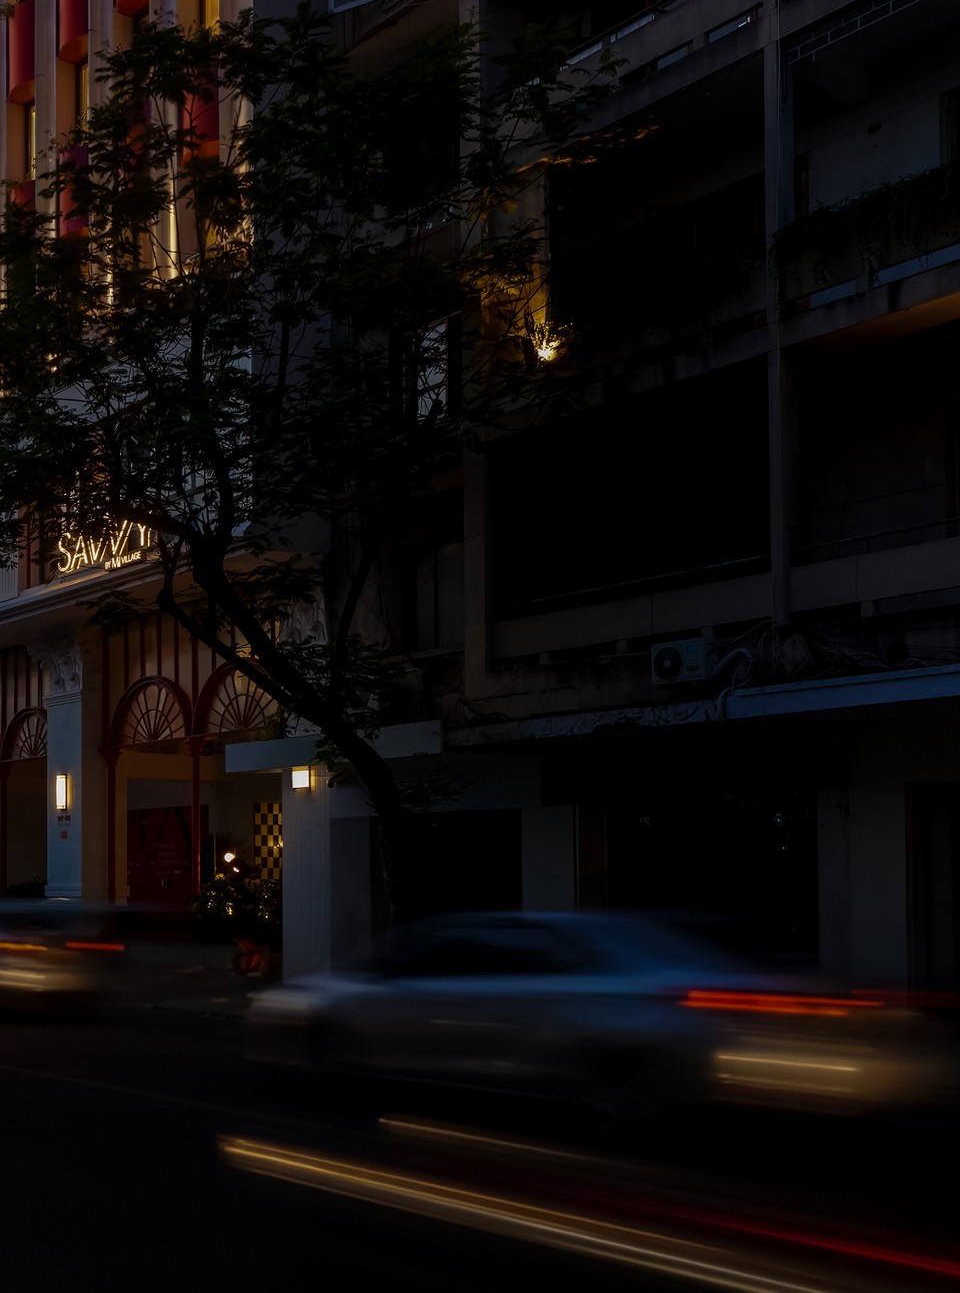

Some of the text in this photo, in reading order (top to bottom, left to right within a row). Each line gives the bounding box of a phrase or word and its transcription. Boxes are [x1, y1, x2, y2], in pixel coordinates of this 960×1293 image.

[58, 520, 150, 573] SAVVY
[104, 560, 112, 570] BY
[121, 551, 142, 564] VILLAGE
